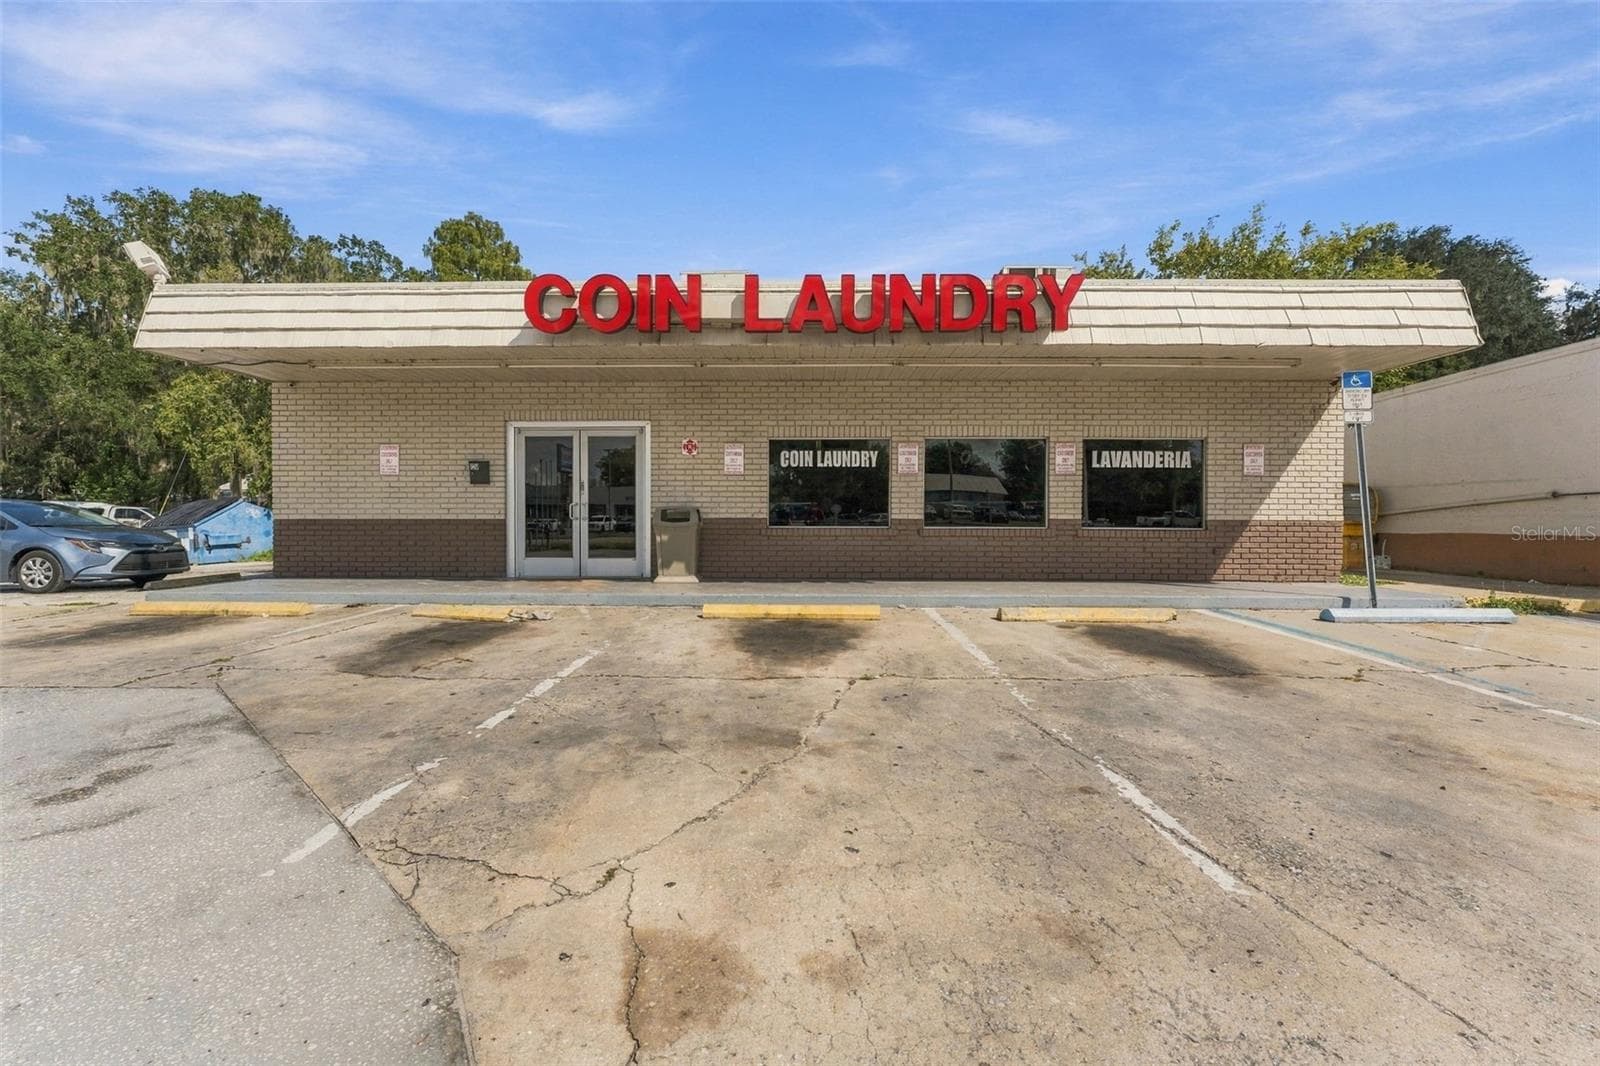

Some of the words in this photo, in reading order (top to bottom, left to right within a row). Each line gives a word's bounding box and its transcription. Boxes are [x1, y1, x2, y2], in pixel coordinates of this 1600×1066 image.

[524, 273, 702, 334] COIN
[744, 273, 1086, 334] LAUNDRY
[779, 449, 813, 468] COIN
[816, 449, 879, 468] LAUNDRY
[1091, 450, 1193, 469] LAVANDERIA
